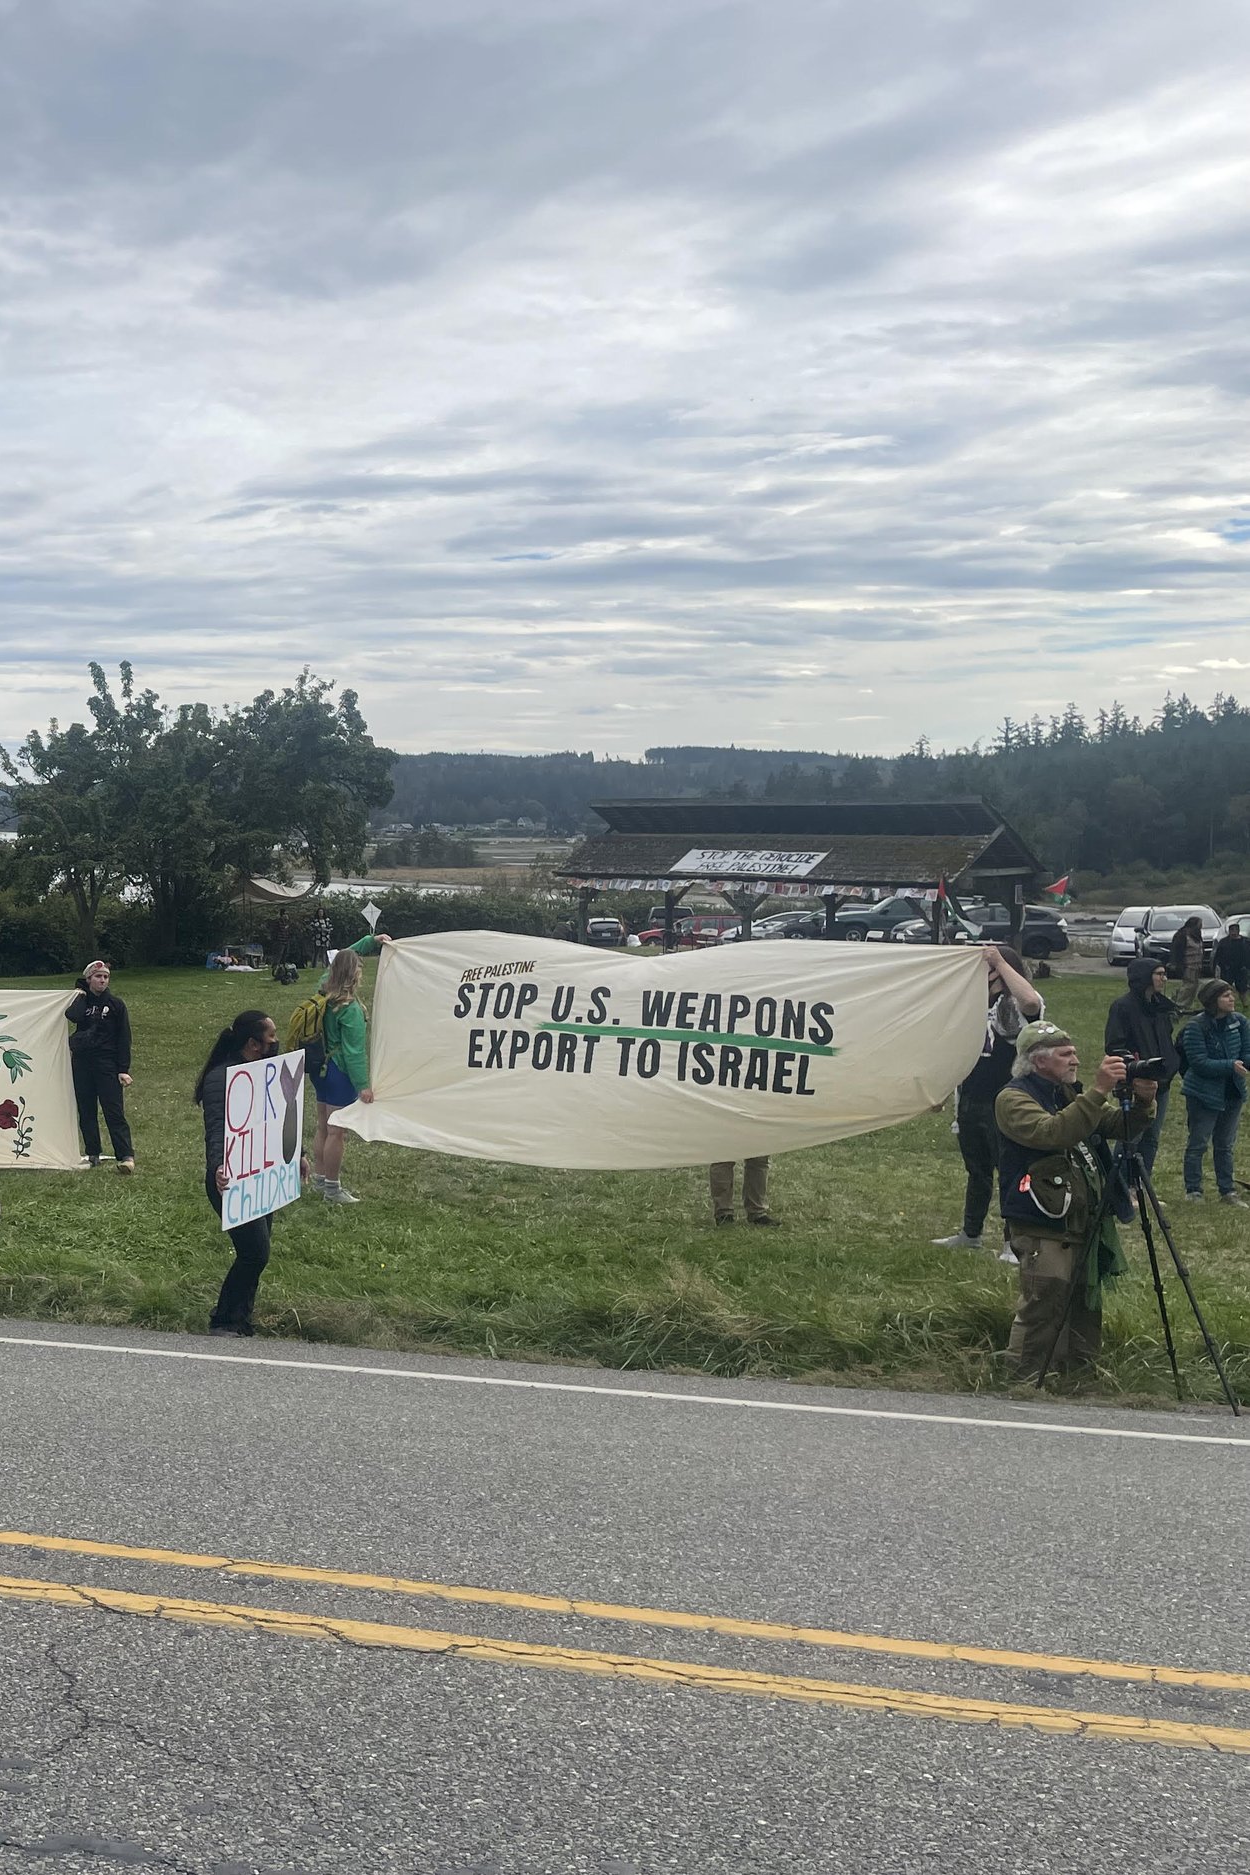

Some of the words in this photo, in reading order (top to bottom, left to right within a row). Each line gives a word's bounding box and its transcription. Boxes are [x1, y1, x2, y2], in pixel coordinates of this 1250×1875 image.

[696, 851, 732, 860] STOP
[735, 851, 758, 861] THE
[759, 852, 820, 864] GENOCIDE
[696, 861, 728, 871] FREE
[727, 862, 800, 875] PALESTINE!
[460, 966, 482, 982] FREE
[483, 960, 537, 979] PALESTINE
[453, 982, 538, 1019] STOP
[551, 985, 620, 1025] U.S.
[642, 990, 835, 1045] WEAPONS
[467, 1029, 600, 1074] EXPORT
[617, 1037, 661, 1079] TO
[677, 1041, 815, 1095] ISRAEL
[225, 1122, 274, 1180] KILL
